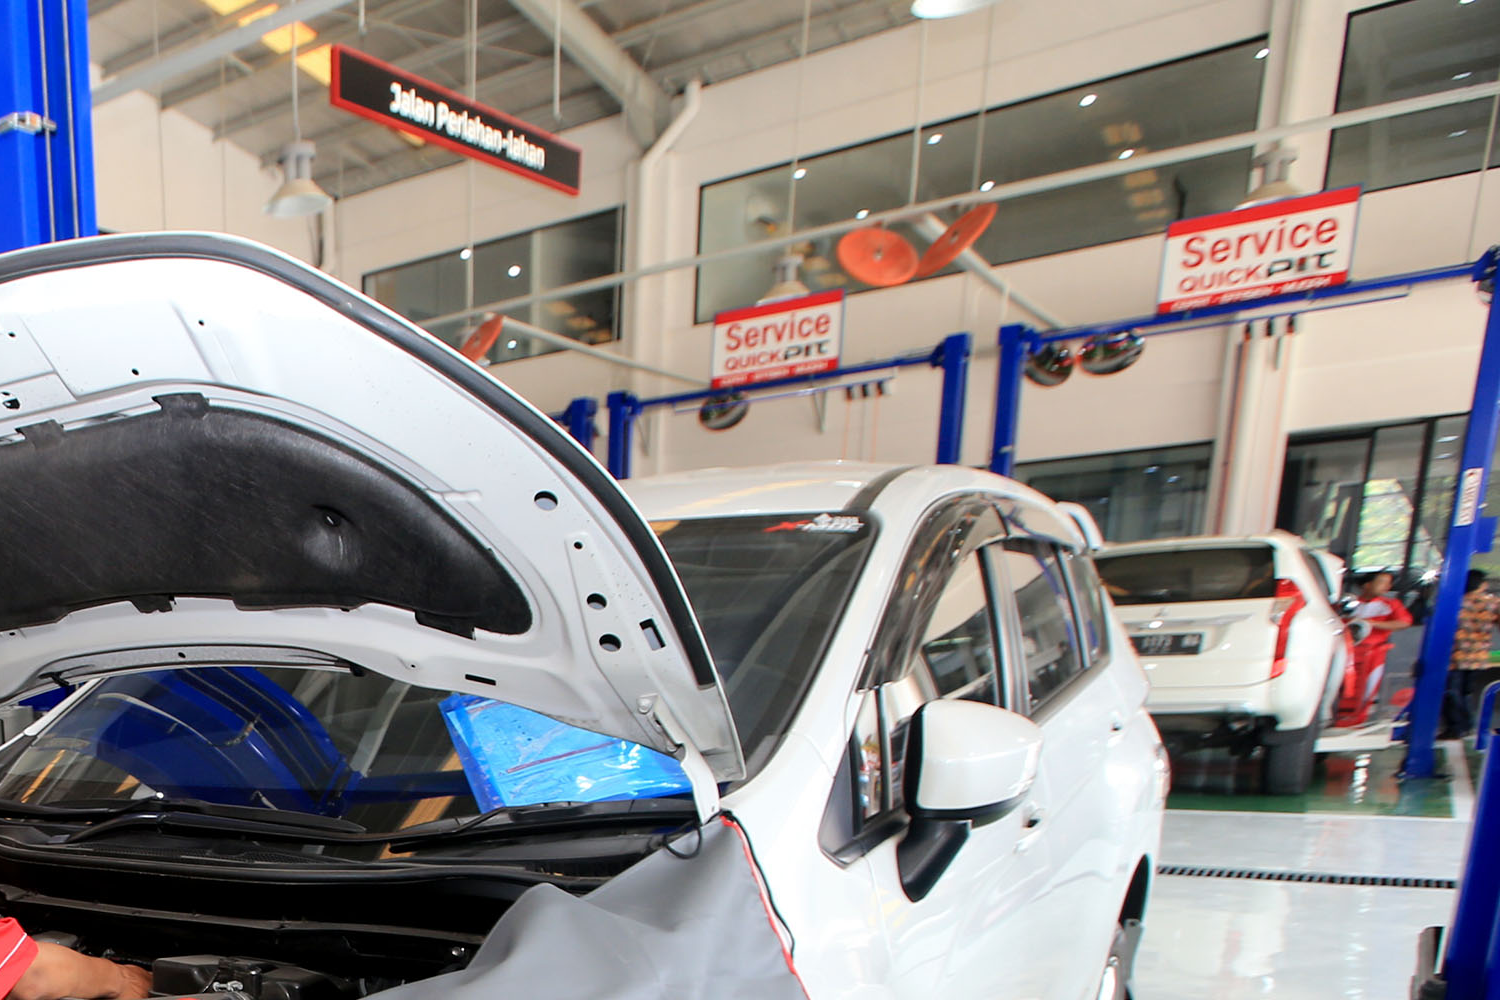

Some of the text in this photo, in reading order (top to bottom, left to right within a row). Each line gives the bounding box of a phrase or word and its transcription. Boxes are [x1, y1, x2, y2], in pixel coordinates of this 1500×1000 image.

[389, 81, 547, 171] Jalan Perlahan-lahan
[1181, 217, 1339, 268] Service
[725, 312, 831, 352] Service
